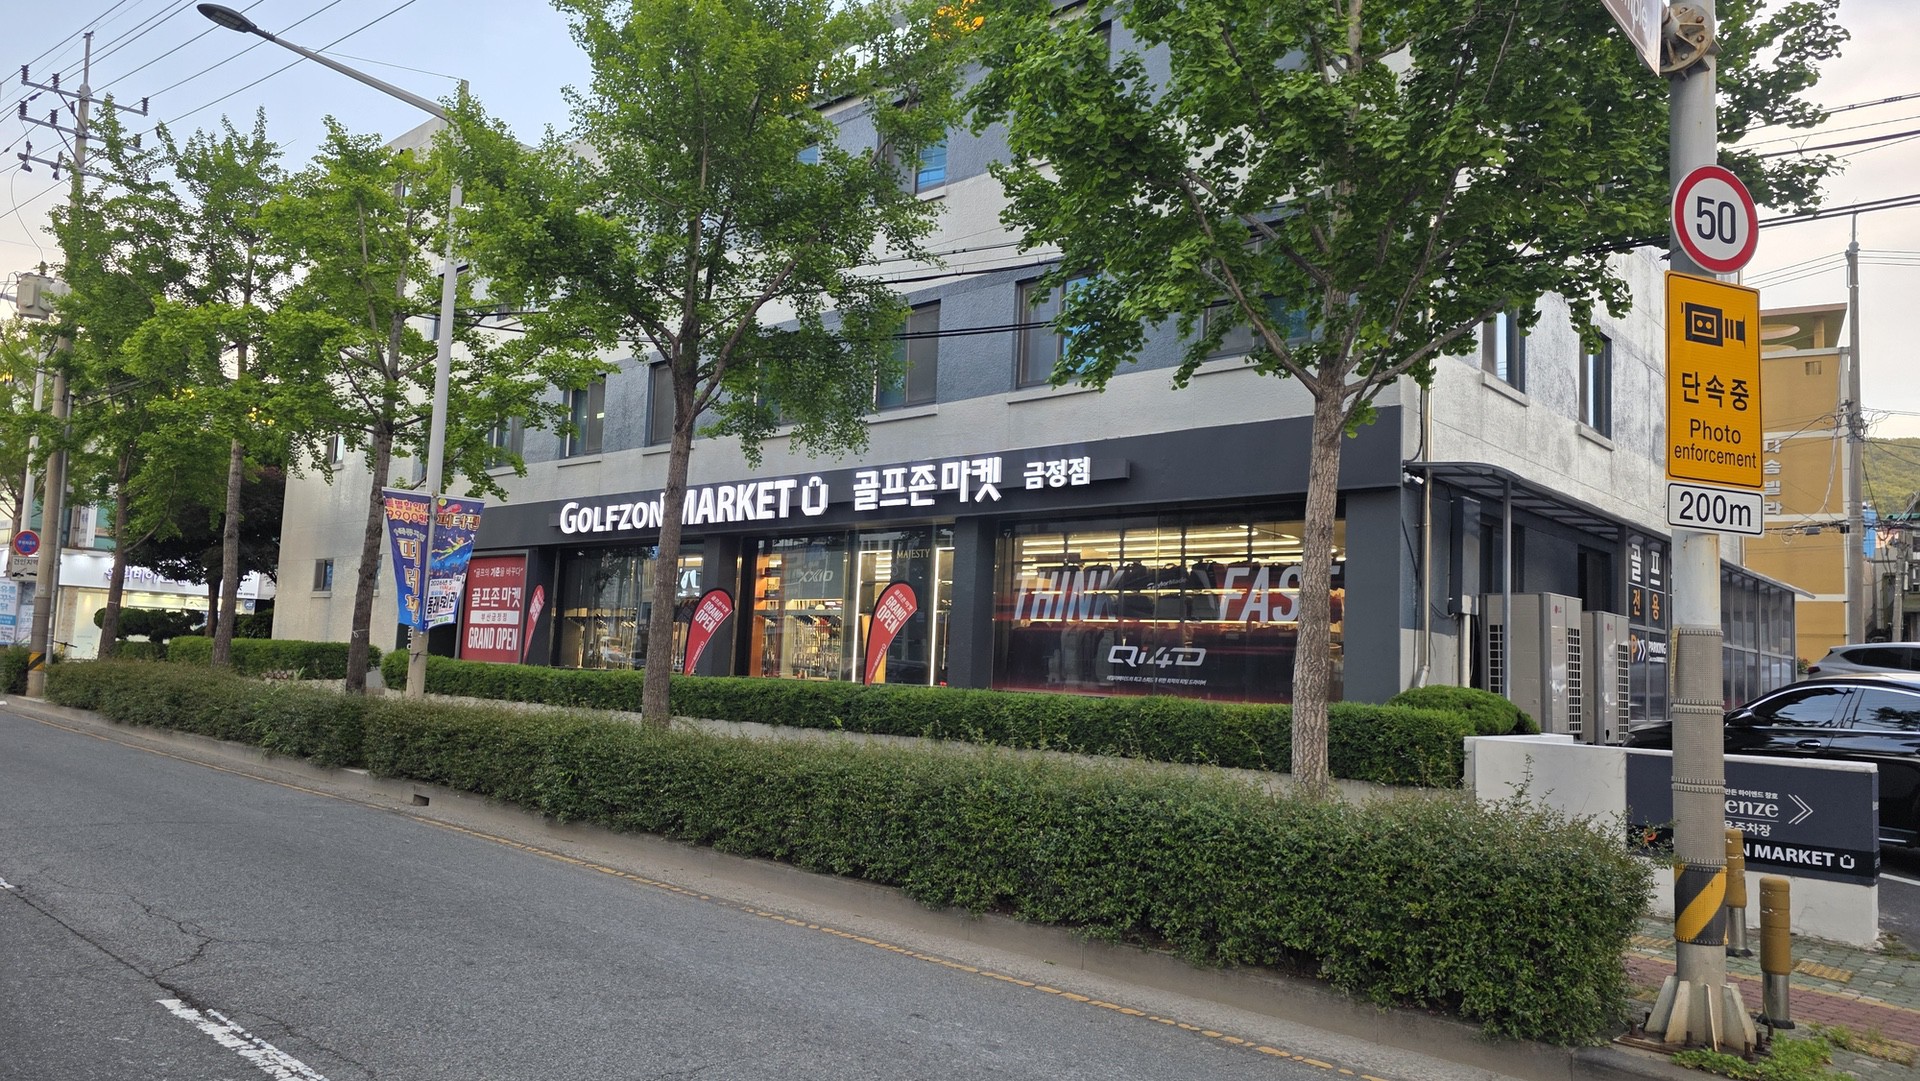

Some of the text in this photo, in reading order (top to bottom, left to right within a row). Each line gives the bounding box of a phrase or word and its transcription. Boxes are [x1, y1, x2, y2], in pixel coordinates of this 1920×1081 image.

[1696, 195, 1736, 245] 50
[1682, 372, 1750, 411] 단속중
[1690, 418, 1742, 444] Photo
[1674, 444, 1757, 469] enforcement
[853, 456, 1091, 511] 골프존마켓 금정점
[559, 492, 664, 534] GOLFZON
[1679, 491, 1752, 527] 200m
[436, 513, 480, 531] 피터팬
[896, 548, 930, 559] MAJESTY
[1014, 570, 1125, 620] THINK
[695, 609, 717, 633] OPEN
[703, 601, 724, 622] GRAND
[876, 605, 900, 634] OPEN
[885, 596, 907, 621] GRAND
[468, 627, 518, 651] GRAND OPEN
[1107, 645, 1207, 669] Qi4D
[1754, 844, 1835, 867] MARKET
